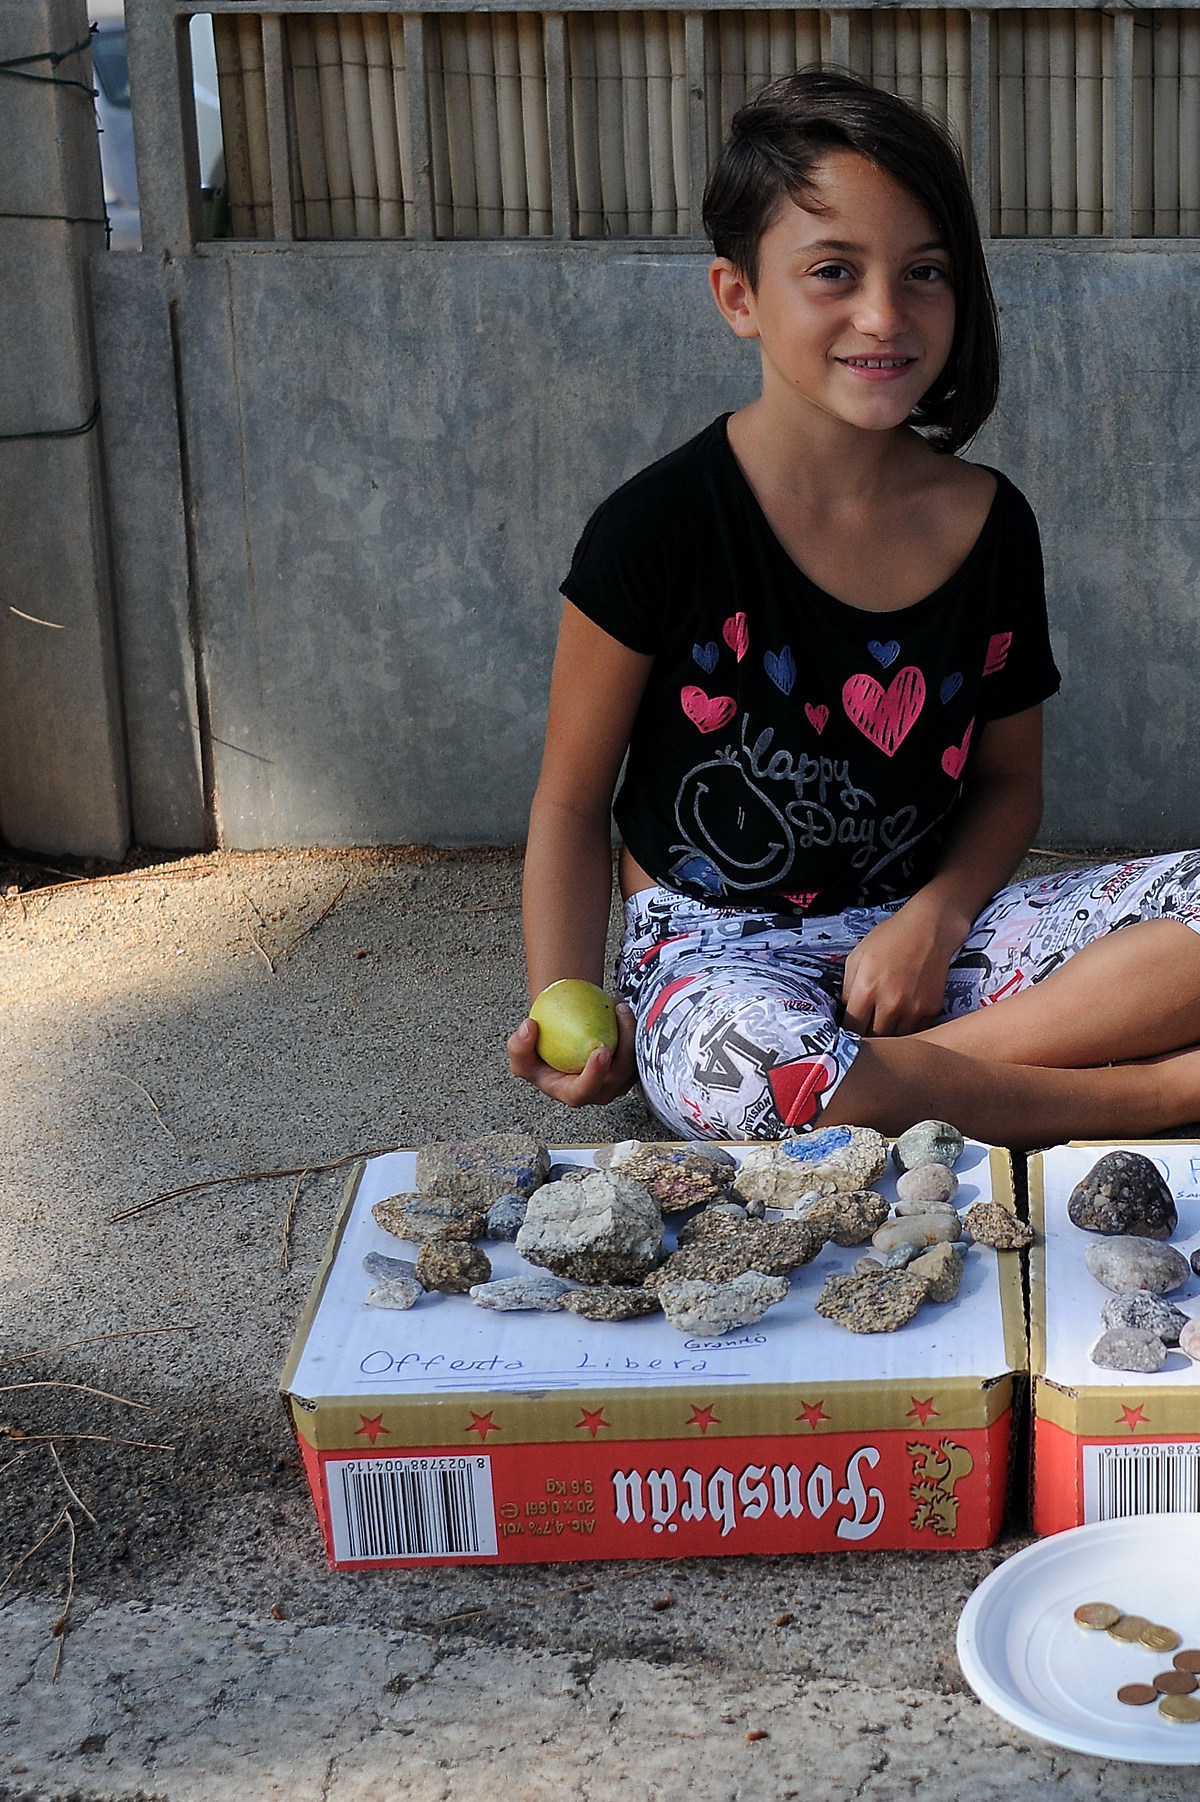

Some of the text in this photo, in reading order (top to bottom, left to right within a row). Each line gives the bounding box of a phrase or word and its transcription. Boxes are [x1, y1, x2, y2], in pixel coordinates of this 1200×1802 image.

[741, 712, 876, 811] Happy
[785, 800, 879, 868] Day
[359, 1349, 708, 1375] Offerta Libera
[546, 1477, 594, 1495] 9,6 Kg
[612, 1445, 886, 1541] Fonsbräu
[577, 1499, 595, 1513] 20
[498, 1519, 596, 1537] Alc. 4,7% vol.
